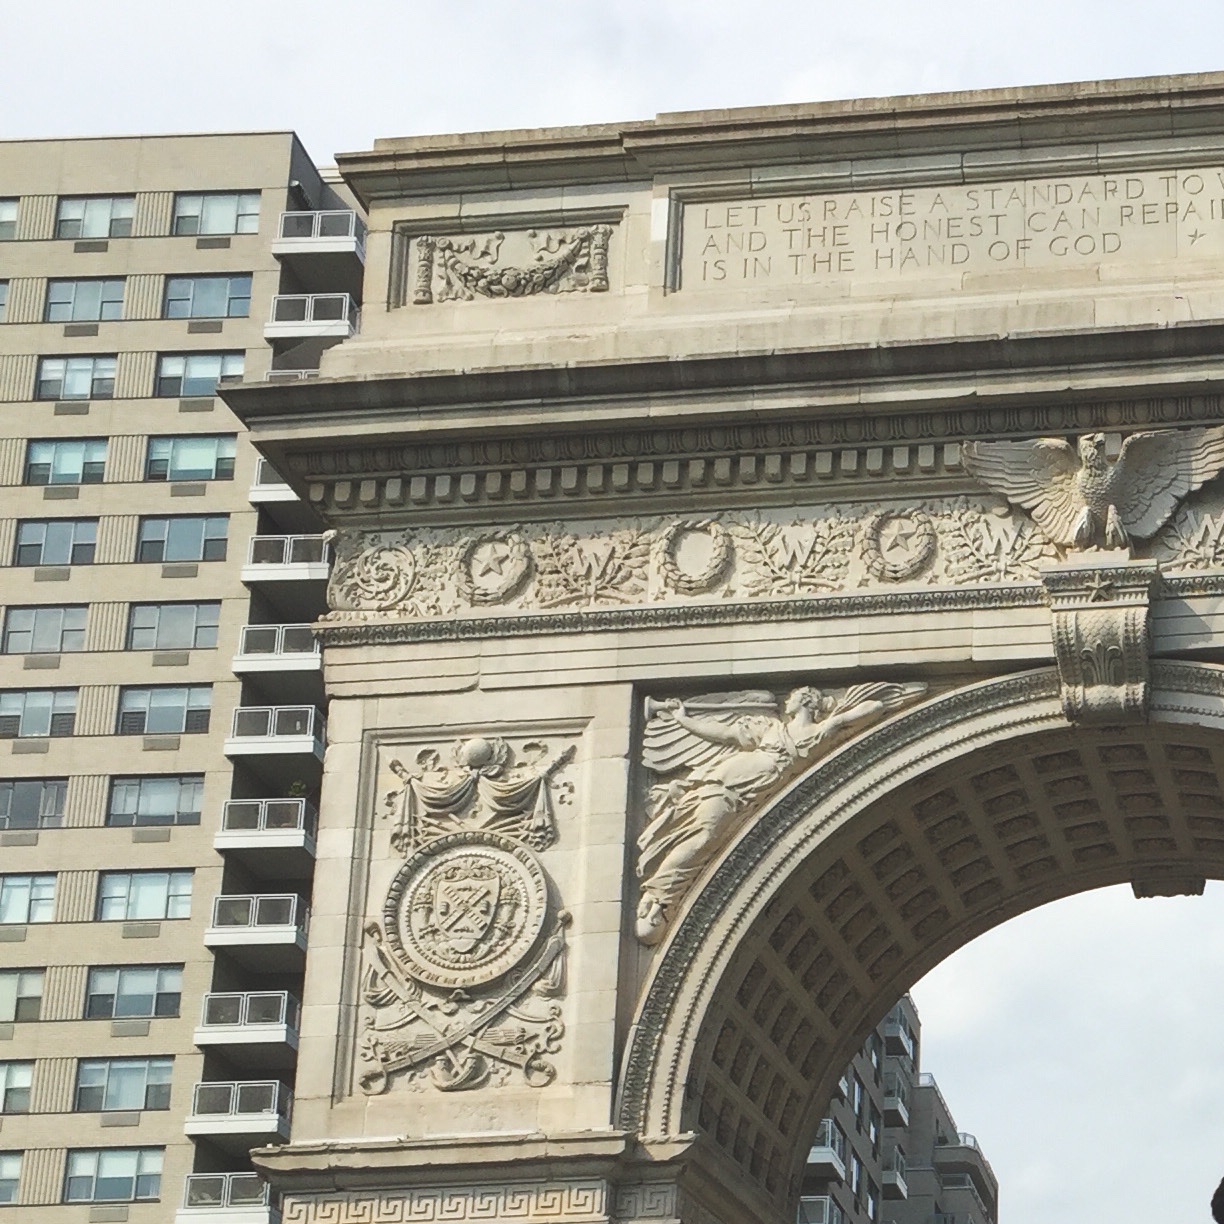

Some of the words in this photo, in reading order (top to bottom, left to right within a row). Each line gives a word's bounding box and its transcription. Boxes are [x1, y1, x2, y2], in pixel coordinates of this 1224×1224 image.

[704, 205, 767, 229] LET
[777, 202, 811, 224] US
[823, 194, 916, 221] RAISE
[929, 193, 949, 214] A
[966, 178, 1145, 211] STANDARD
[1159, 174, 1204, 197] TO
[702, 231, 767, 256] AND
[782, 225, 850, 250] THE
[871, 214, 1008, 244] HONEST
[1027, 207, 1101, 232] CAN
[703, 260, 728, 282] IS
[743, 256, 772, 279] IN
[788, 251, 856, 276] THE
[874, 243, 970, 270] HAND
[988, 238, 1033, 262] OF
[1049, 232, 1122, 257] GOD
